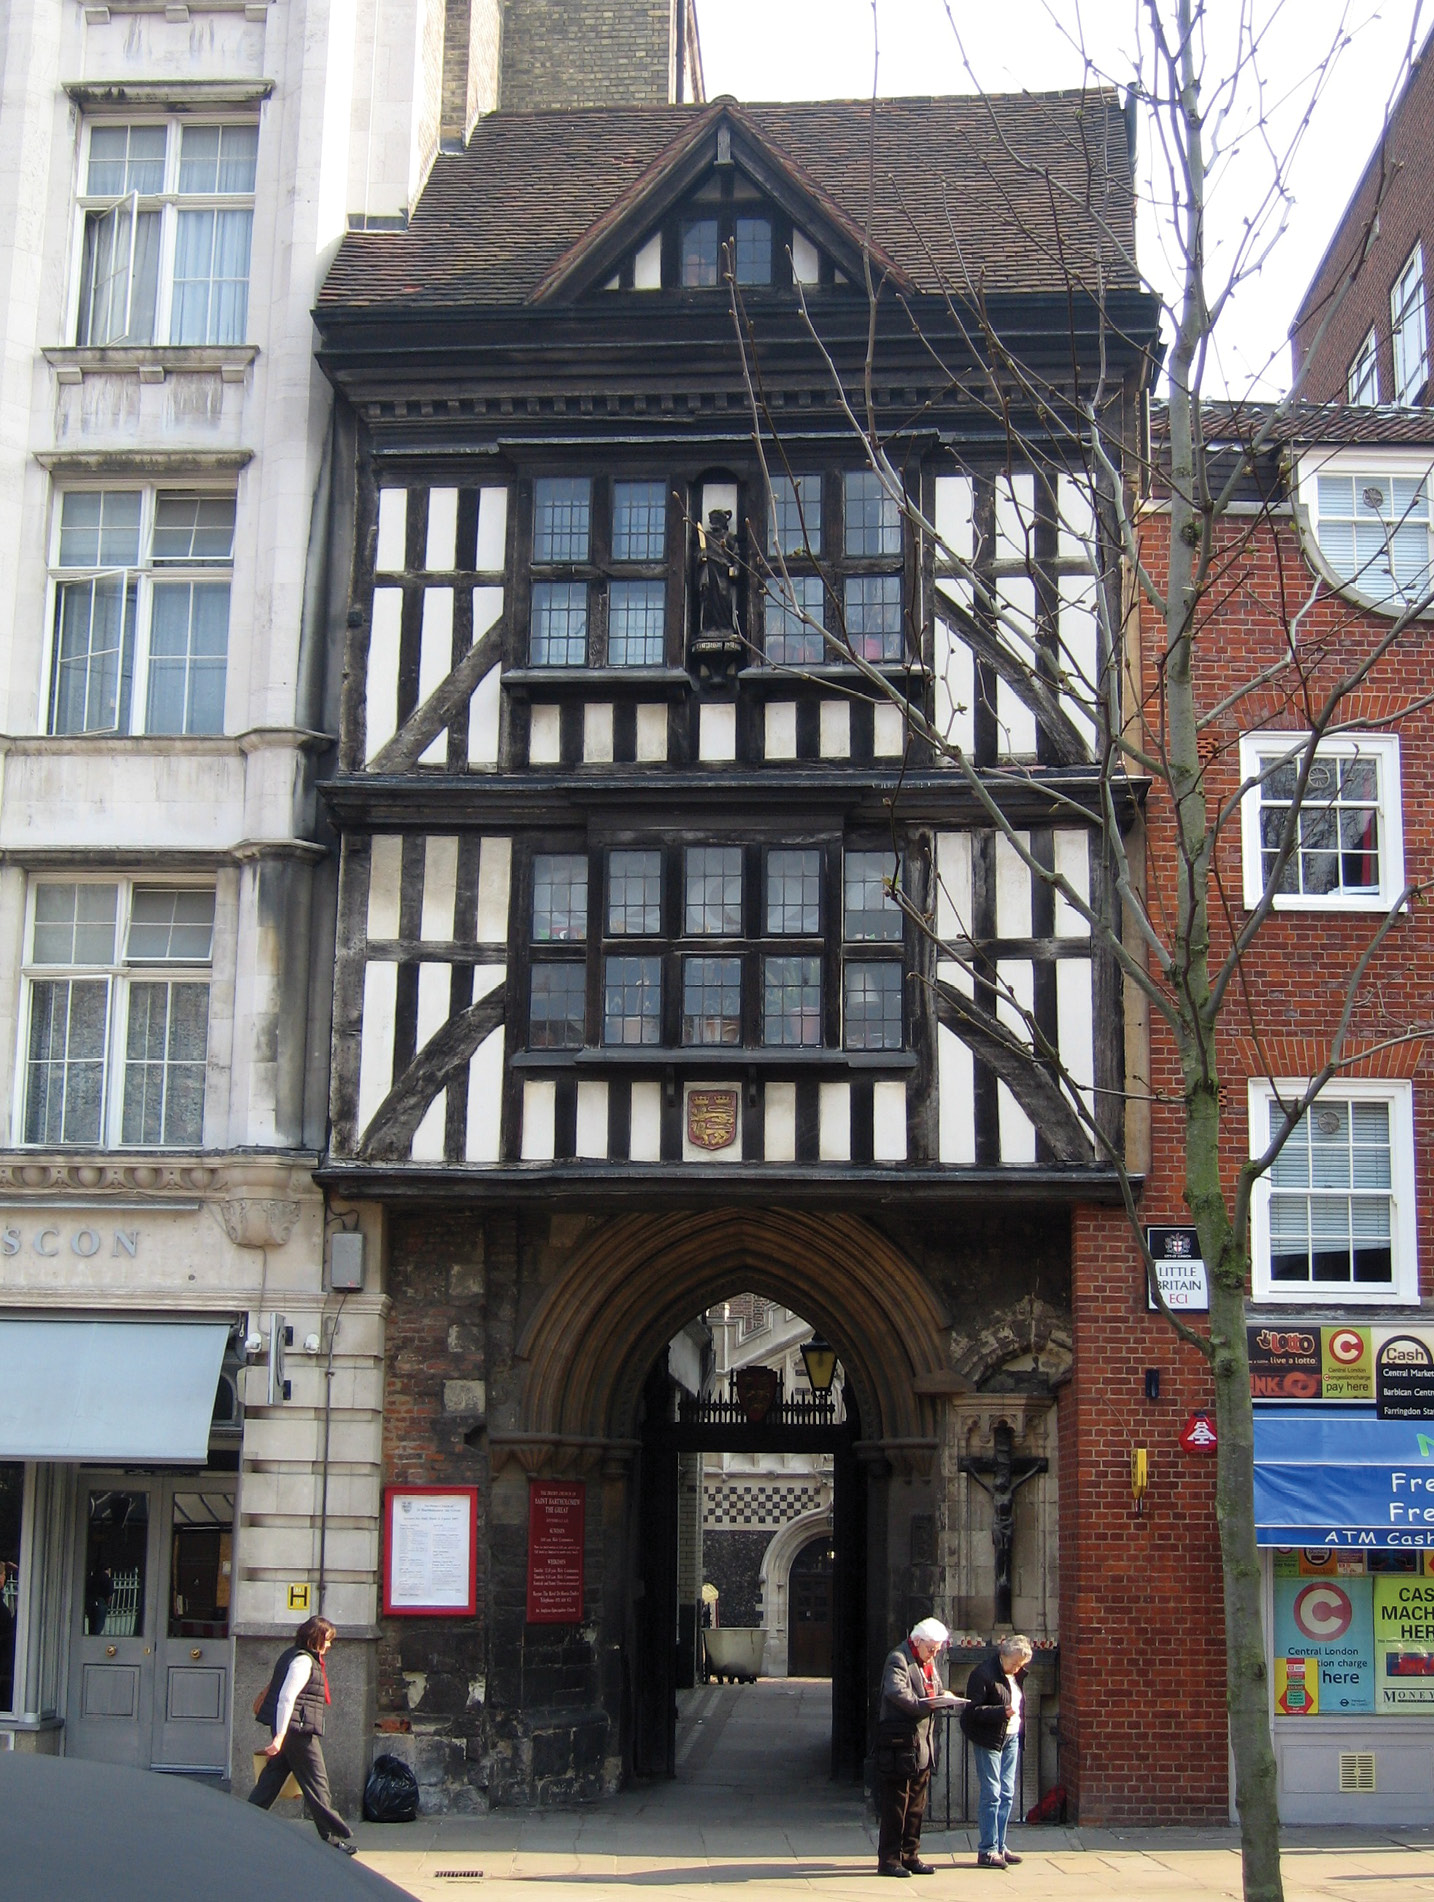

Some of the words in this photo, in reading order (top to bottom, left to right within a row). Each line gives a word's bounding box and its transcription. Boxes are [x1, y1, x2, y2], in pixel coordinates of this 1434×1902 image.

[0, 1227, 139, 1258] SCON
[1159, 1267, 1197, 1277] LITTLE
[1157, 1280, 1202, 1291] BRITAIN
[1386, 1347, 1424, 1361] Cash
[1270, 1356, 1287, 1365] live
[1295, 1357, 1316, 1365] lotto
[1383, 1368, 1408, 1377] Central
[1410, 1368, 1434, 1378] Market
[1326, 1383, 1344, 1393] pay
[1346, 1382, 1369, 1391] here
[1383, 1387, 1412, 1396] Barbican
[1384, 1406, 1421, 1417] Farringdon
[1324, 1531, 1377, 1544] ATM
[1386, 1532, 1434, 1545] Cash
[290, 1586, 307, 1607] H
[1398, 1587, 1434, 1602] CAS
[1381, 1605, 1434, 1620] MACH
[1288, 1647, 1321, 1656] Central
[1324, 1647, 1359, 1656] London
[1337, 1659, 1368, 1669] charge
[1322, 1669, 1359, 1684] here
